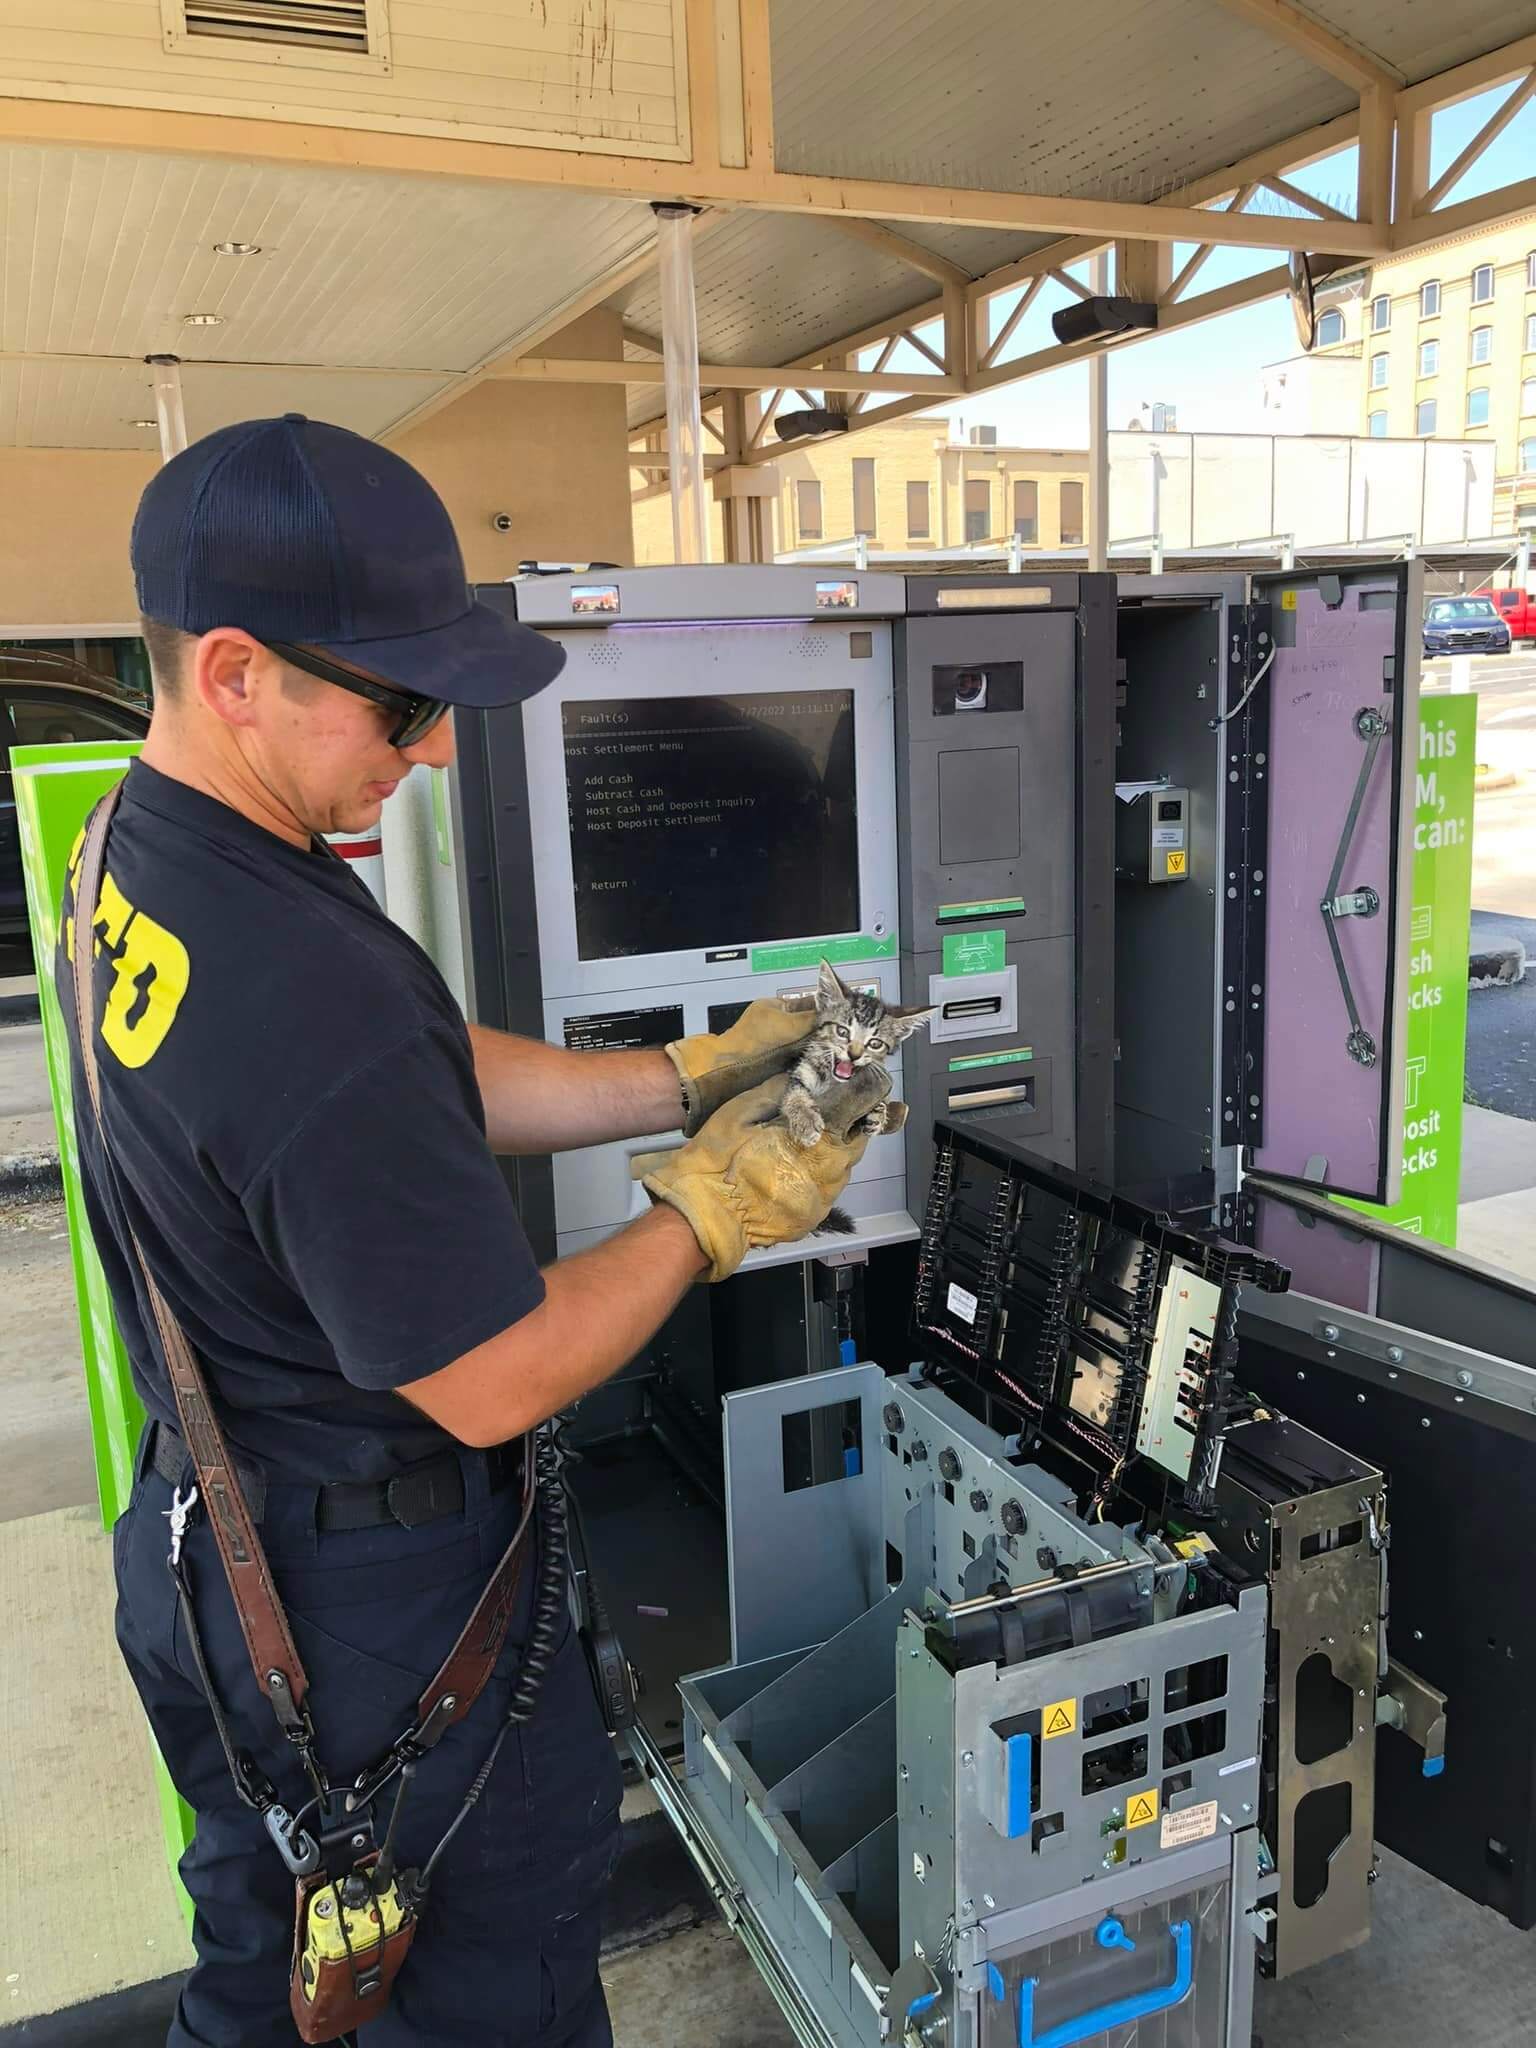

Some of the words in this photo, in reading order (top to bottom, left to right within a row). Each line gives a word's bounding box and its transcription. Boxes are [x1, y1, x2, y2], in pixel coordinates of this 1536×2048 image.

[580, 712, 630, 725] Fault(s)
[593, 743, 654, 755] Settlement
[659, 742, 684, 752] Menu
[584, 775, 604, 785] Add
[608, 774, 633, 785] Cash
[585, 789, 634, 801] Subtract
[639, 787, 664, 798] Cash
[586, 806, 611, 817] Host
[616, 803, 641, 814] Cash
[646, 802, 665, 812] and
[669, 799, 711, 811] Deposit
[716, 797, 756, 808] Inquiry
[587, 820, 612, 831] Host
[617, 817, 660, 830] Deposit
[664, 814, 722, 826] Settlement
[1414, 817, 1465, 850] can:
[591, 880, 628, 891] Return
[1408, 983, 1442, 1010] cks
